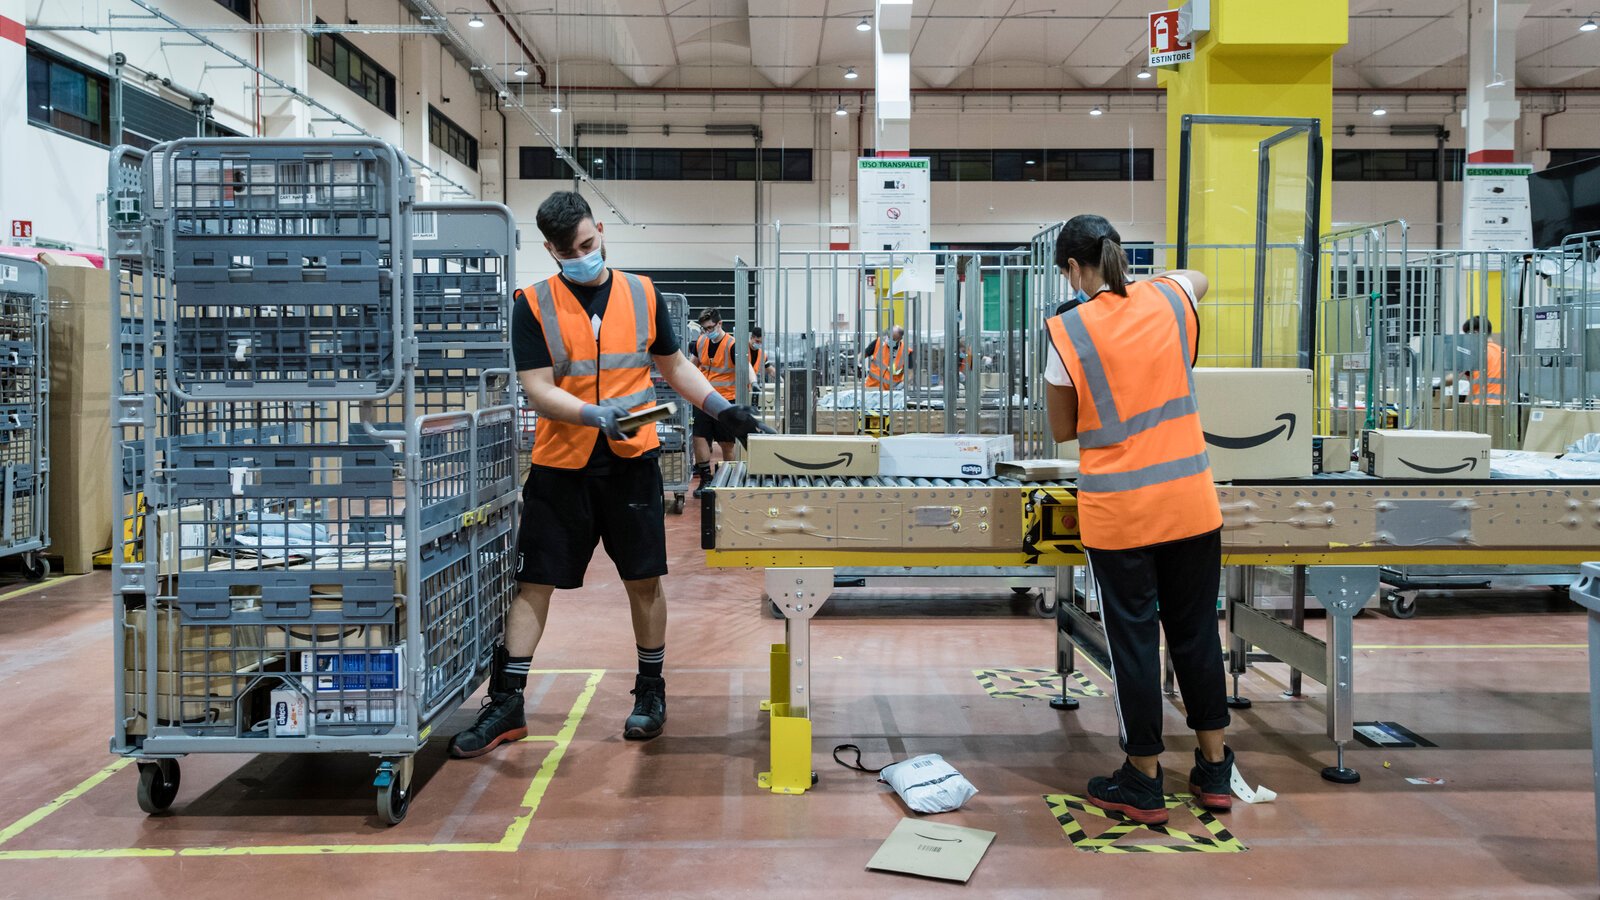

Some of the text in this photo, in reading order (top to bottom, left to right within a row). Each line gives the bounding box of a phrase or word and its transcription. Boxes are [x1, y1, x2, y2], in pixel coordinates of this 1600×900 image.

[1151, 52, 1191, 64] ESTINTORE
[1466, 168, 1531, 176] GESTIONE PALLET
[277, 702, 287, 725] chicco
